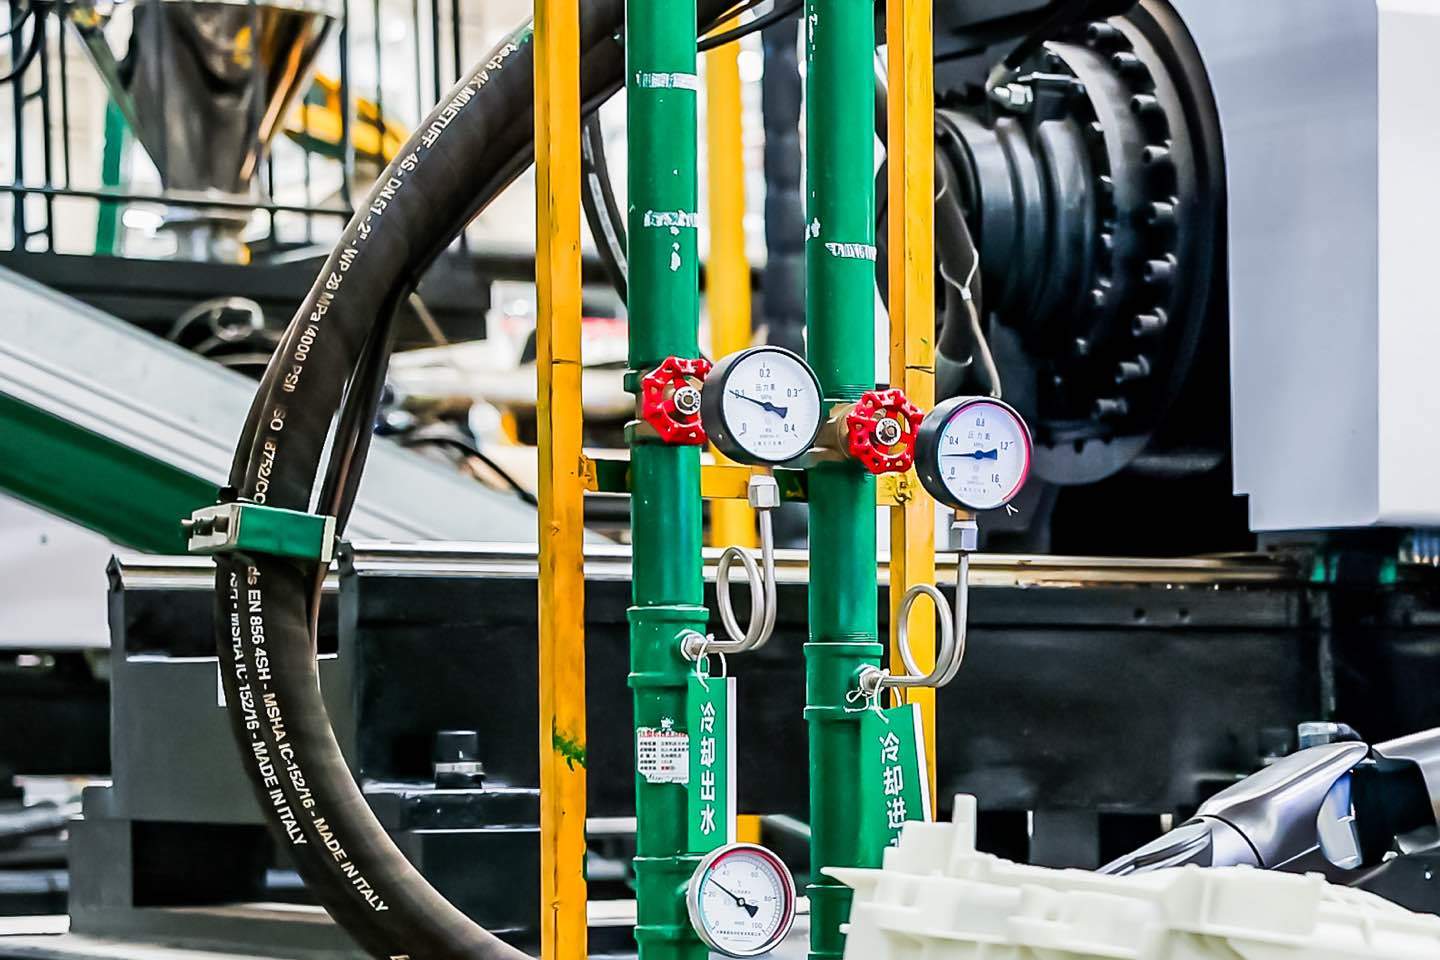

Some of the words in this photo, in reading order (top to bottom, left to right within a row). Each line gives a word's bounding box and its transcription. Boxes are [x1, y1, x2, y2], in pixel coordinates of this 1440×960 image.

[470, 70, 489, 89] 4K
[421, 88, 476, 148] MINETUFF
[400, 153, 419, 171] 4S
[380, 177, 403, 200] DN
[370, 198, 387, 216] 51
[339, 248, 358, 271] WP
[326, 272, 342, 290] 28
[310, 291, 334, 322] MPa
[294, 325, 319, 361] (4000
[759, 368, 771, 378] 0.2
[787, 388, 798, 398] 0.3
[784, 423, 795, 433] 0.4
[949, 435, 959, 446] 0.4
[248, 589, 262, 613] EN
[250, 616, 265, 645] 856
[254, 648, 272, 681] 4SH
[262, 692, 287, 742] MSHA
[252, 741, 279, 788] MADE
[278, 742, 316, 809] IC-152/16
[699, 701, 717, 836] 冷却出水
[269, 787, 285, 807] IN
[276, 806, 308, 846] ITALY
[312, 817, 347, 862] MADE
[340, 855, 359, 879] IN
[352, 876, 389, 913] ITALY
